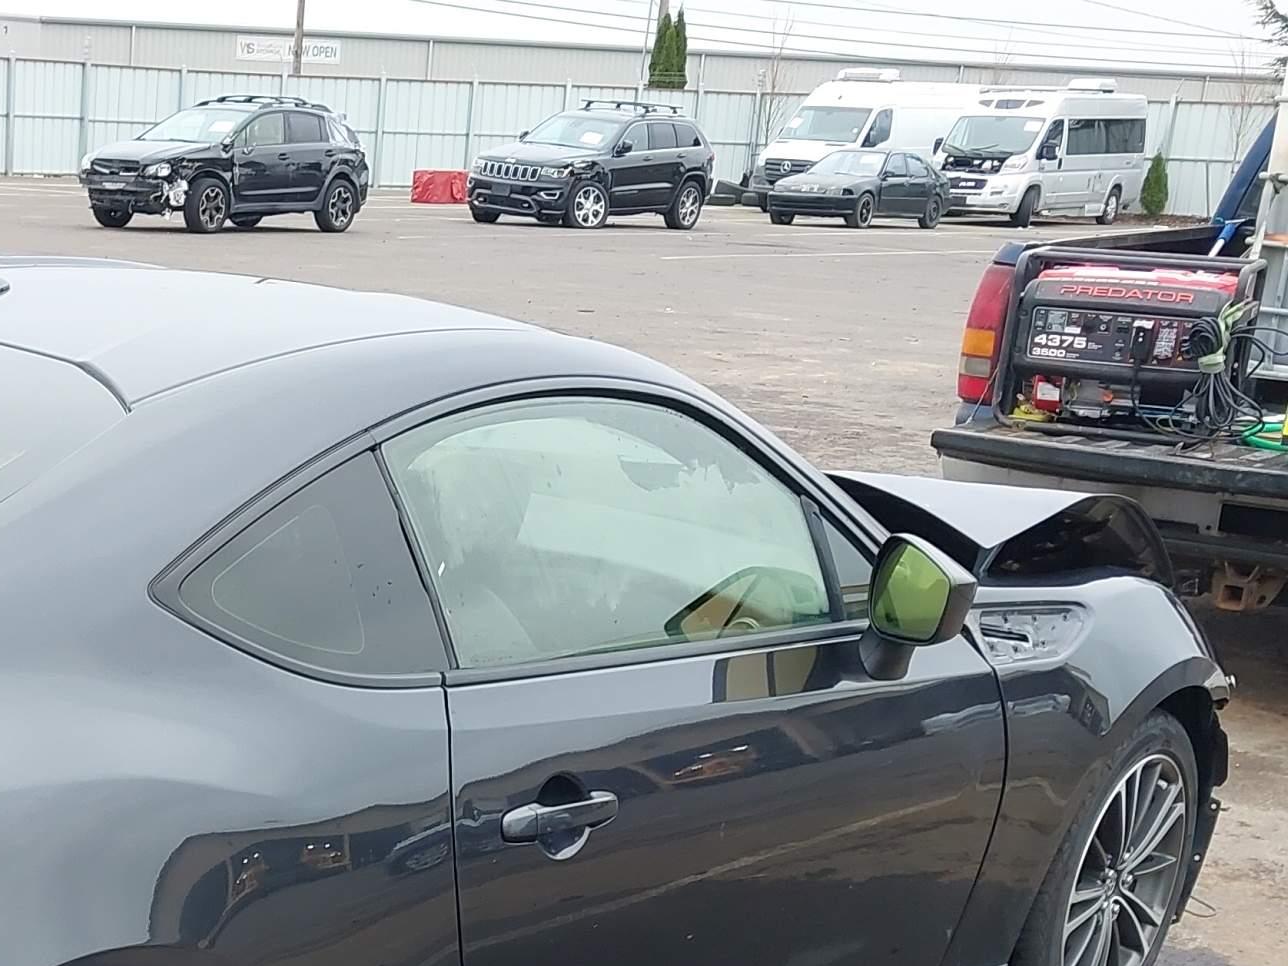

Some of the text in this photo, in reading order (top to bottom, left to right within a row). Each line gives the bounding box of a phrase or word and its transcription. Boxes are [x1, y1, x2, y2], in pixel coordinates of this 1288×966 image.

[288, 44, 311, 57] NW
[312, 45, 337, 58] OPEN
[1059, 284, 1195, 304] PREDATOR
[1033, 333, 1087, 349] 4375
